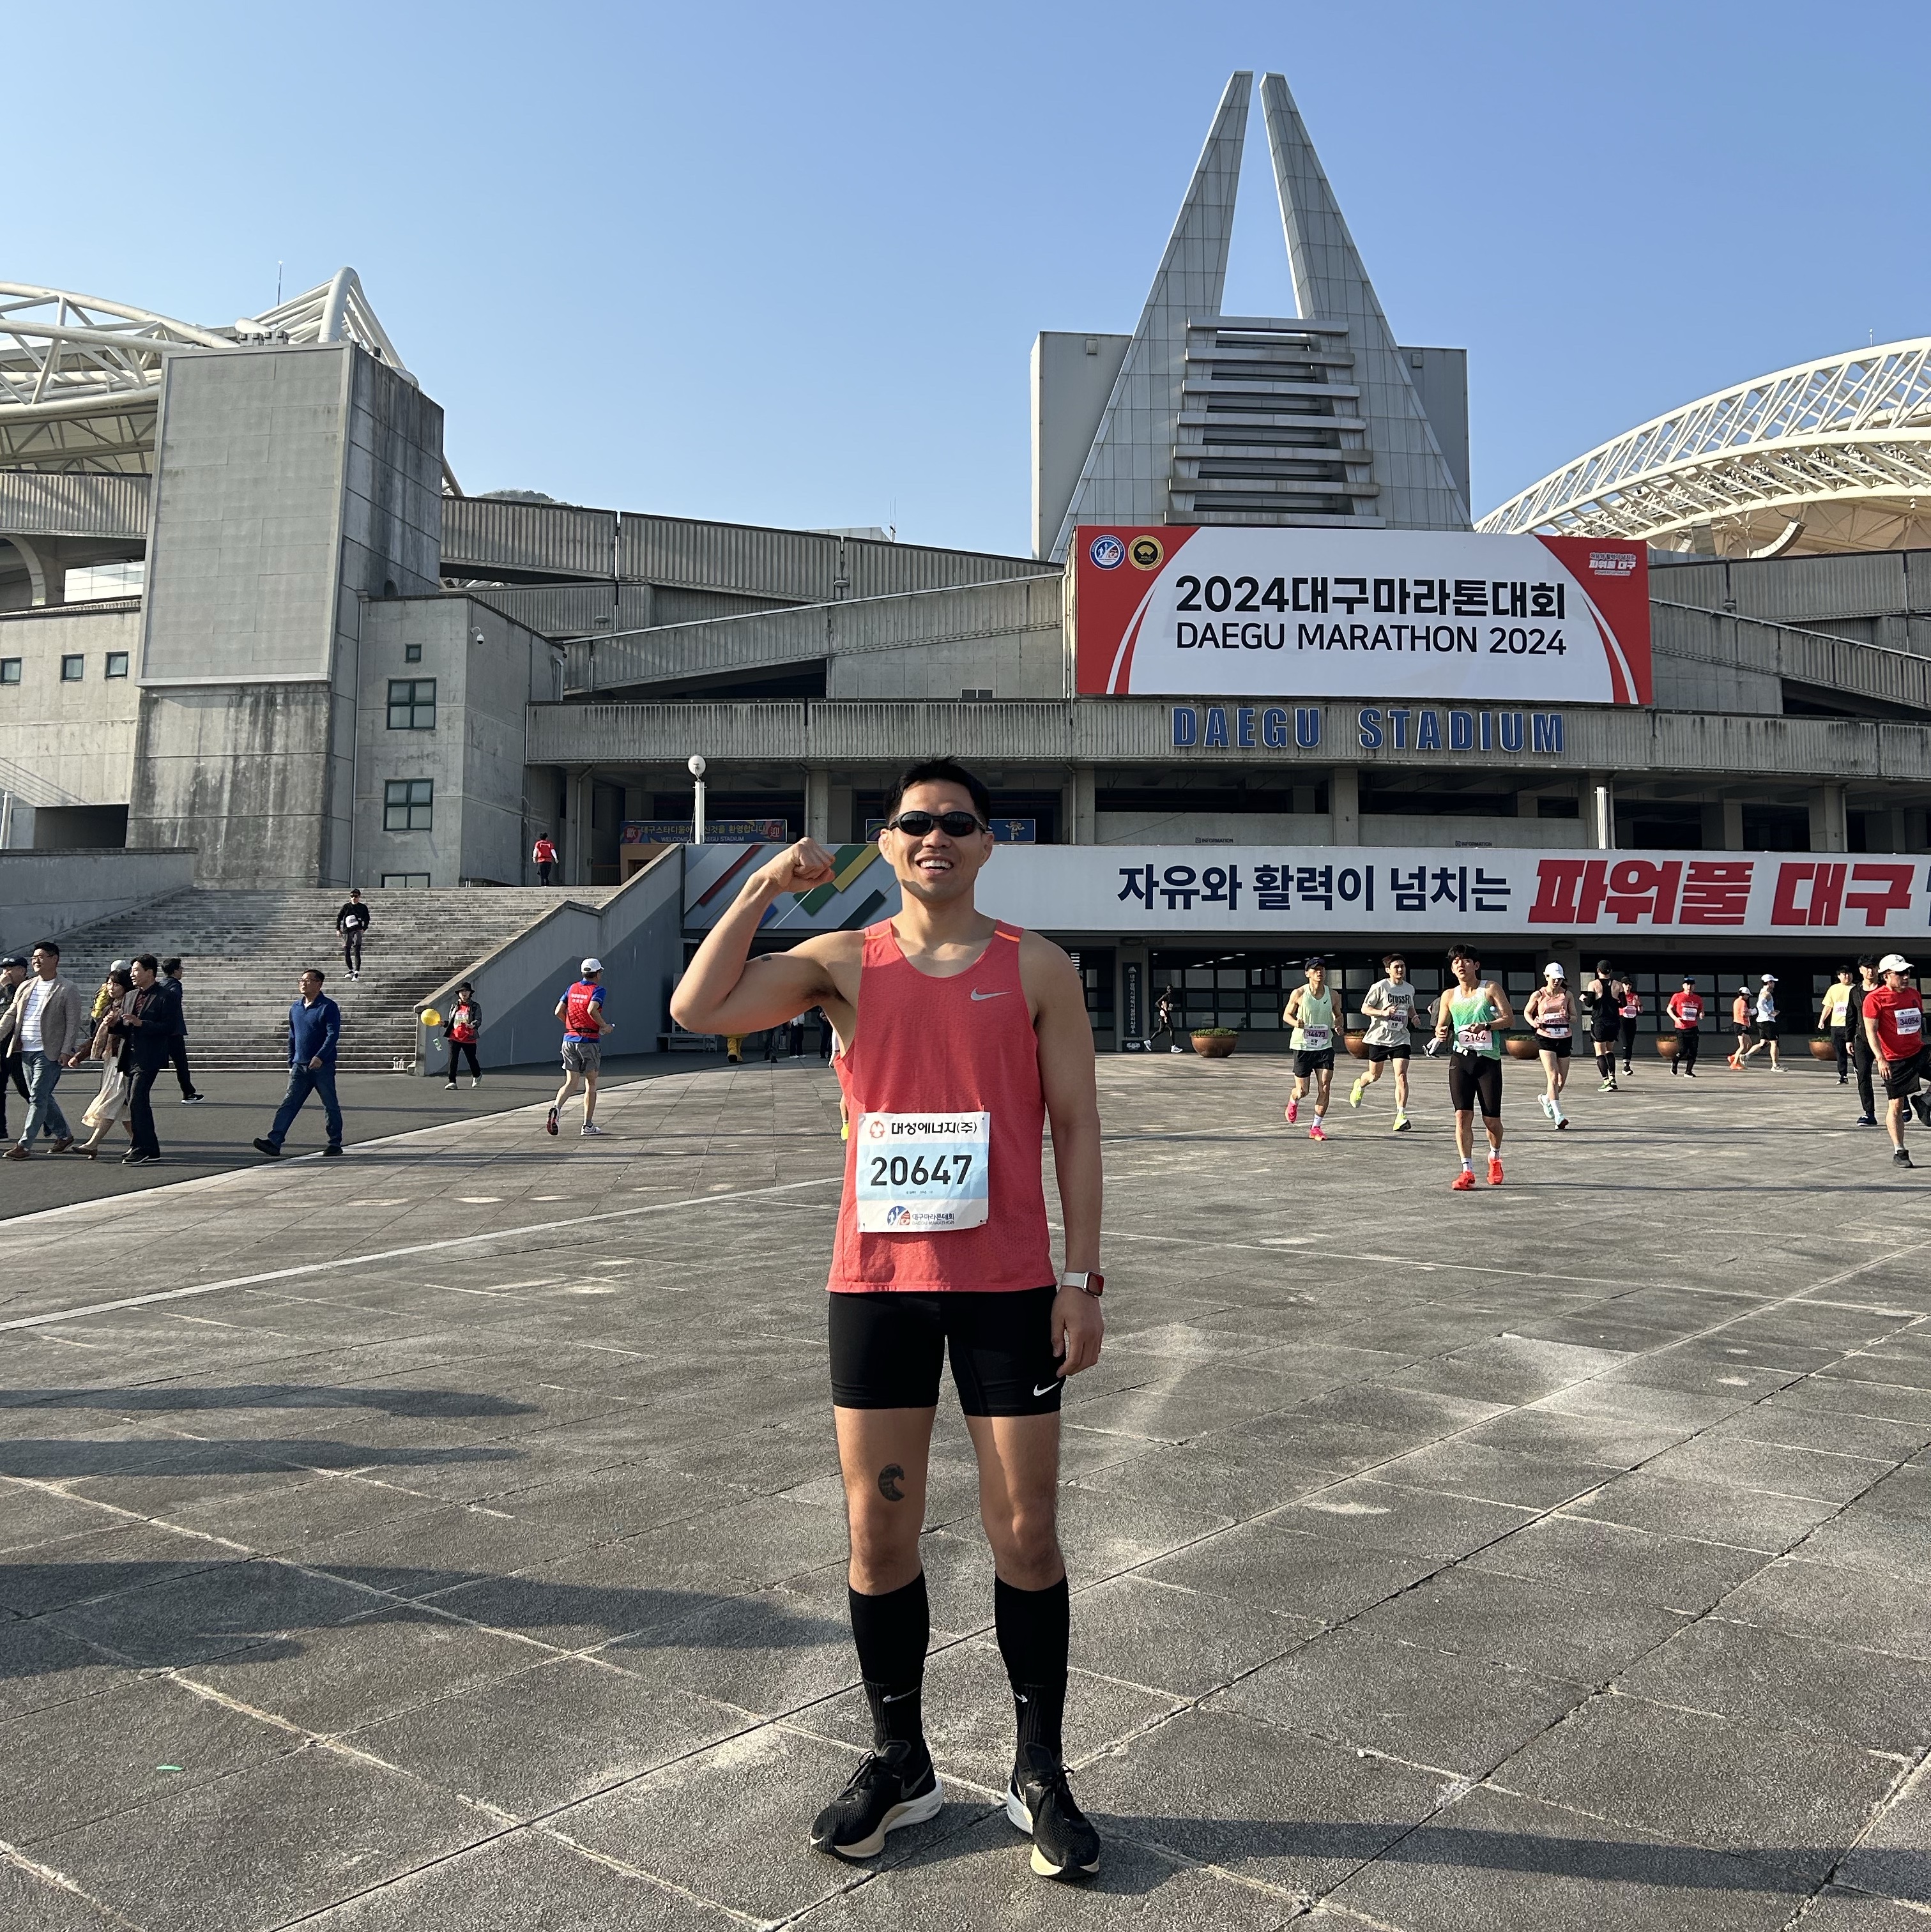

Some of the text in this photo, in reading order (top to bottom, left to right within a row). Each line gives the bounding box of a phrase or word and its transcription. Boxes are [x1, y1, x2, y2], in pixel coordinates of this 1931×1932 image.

[1175, 575, 1565, 620] 2024대구마라톤대회
[1177, 622, 1567, 655] DAEGU MARATHON 2024
[1172, 706, 1564, 752] DAEGU STADIUM
[729, 825, 765, 834] 환영합니다
[1117, 863, 1242, 911] 자유와
[1253, 864, 1374, 911] 활력이
[1391, 865, 1511, 912] 넘치는
[1527, 859, 1755, 925] 파워풀
[1770, 862, 1915, 927] 대구
[1464, 1033, 1486, 1042] 2164
[891, 1121, 977, 1135] 대성에너지(주)
[871, 1155, 972, 1186] 20647
[912, 1213, 954, 1221] 대구마라톤대회
